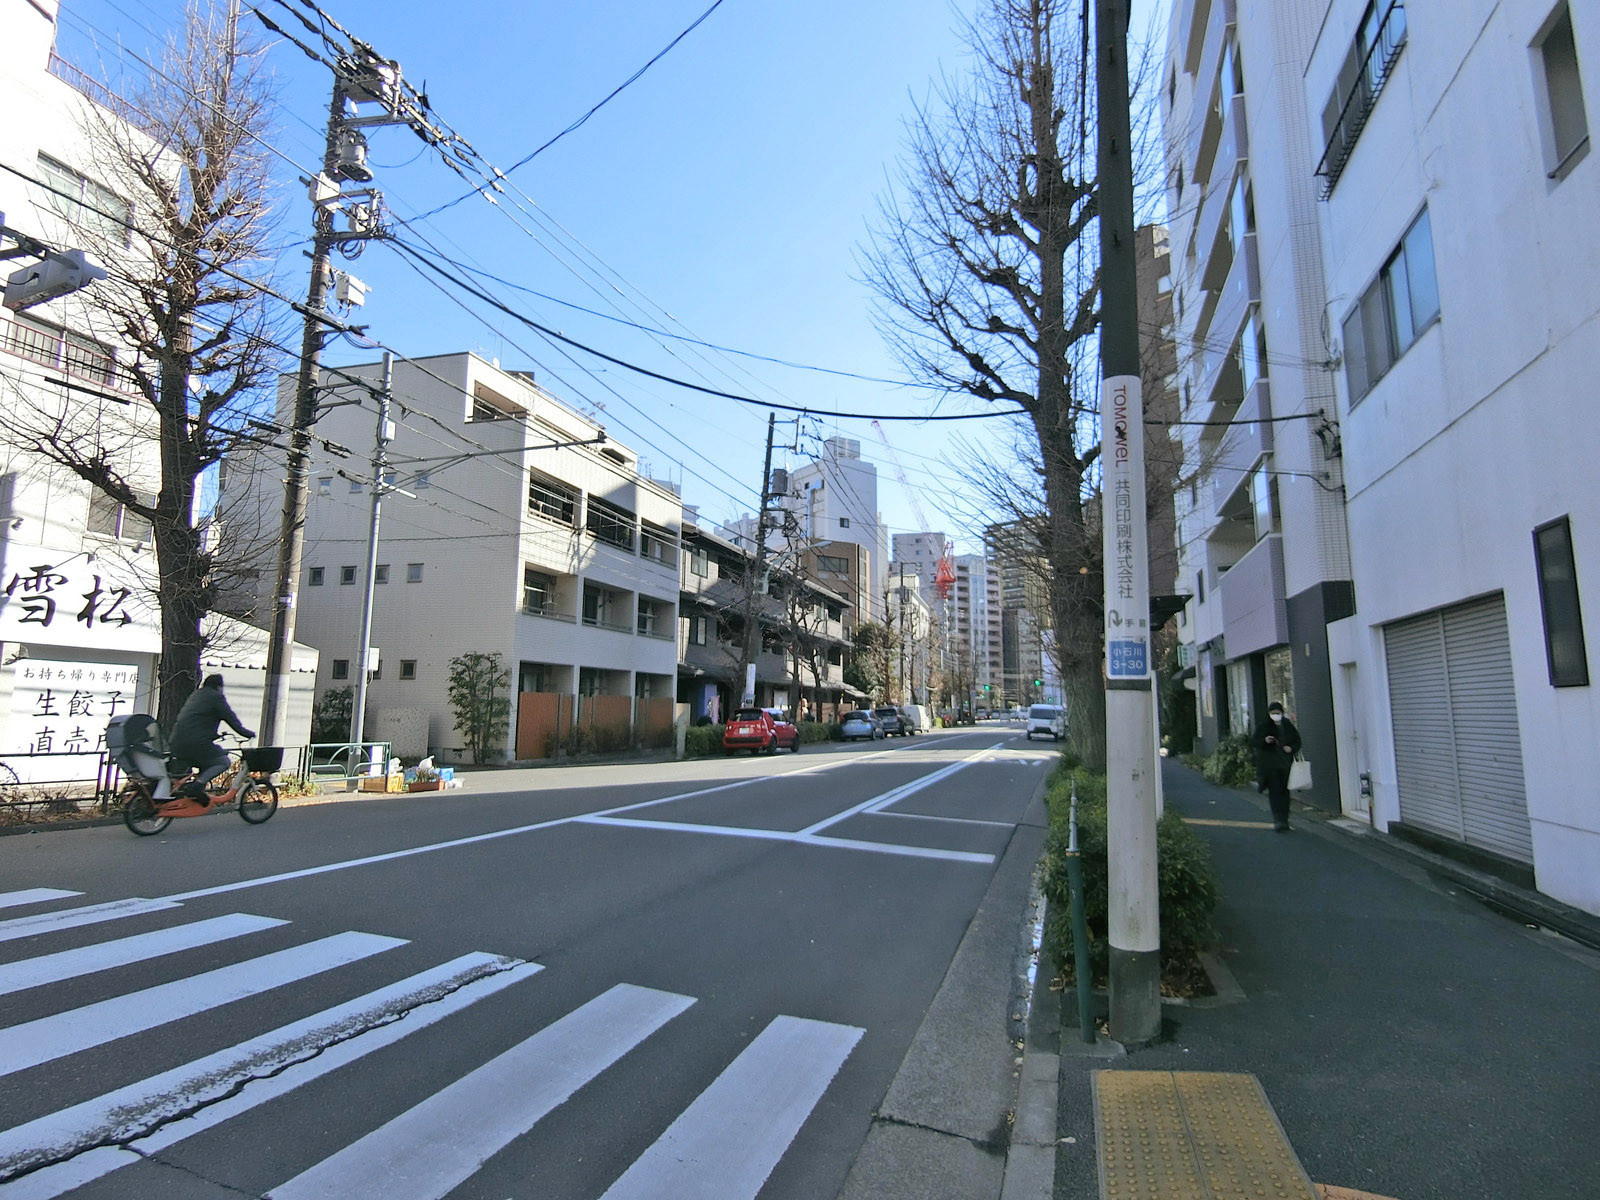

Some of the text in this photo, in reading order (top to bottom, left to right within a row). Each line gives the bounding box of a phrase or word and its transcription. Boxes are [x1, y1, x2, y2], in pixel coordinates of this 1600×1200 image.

[1115, 479, 1134, 599] 共同印刷株式会社
[6, 564, 132, 628] 雪松
[1113, 647, 1142, 657] 小石川
[24, 667, 139, 684] お持ち帰り専門店
[1113, 660, 1143, 669] 3-30
[32, 688, 126, 718] 生餃子
